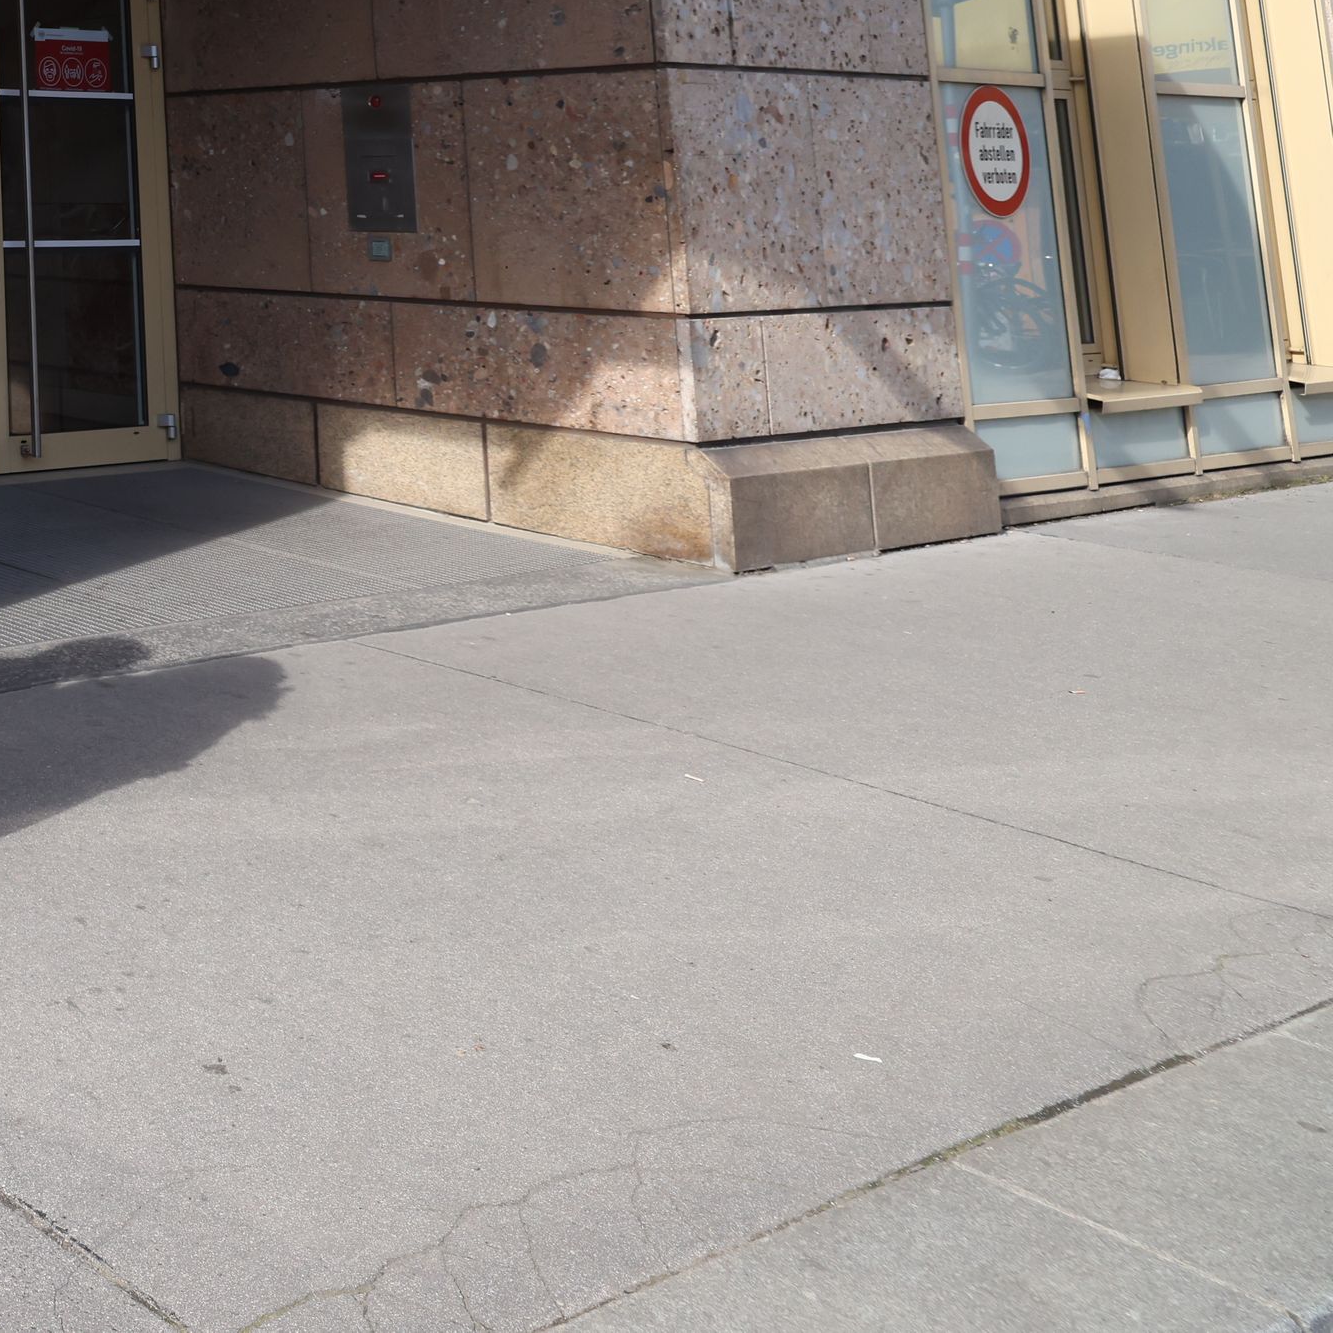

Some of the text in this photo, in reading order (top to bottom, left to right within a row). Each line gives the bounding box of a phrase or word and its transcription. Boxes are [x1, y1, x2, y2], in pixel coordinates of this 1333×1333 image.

[974, 122, 1014, 140] Fahrräder
[978, 146, 1015, 162] abstellen
[982, 168, 1017, 185] verboten
